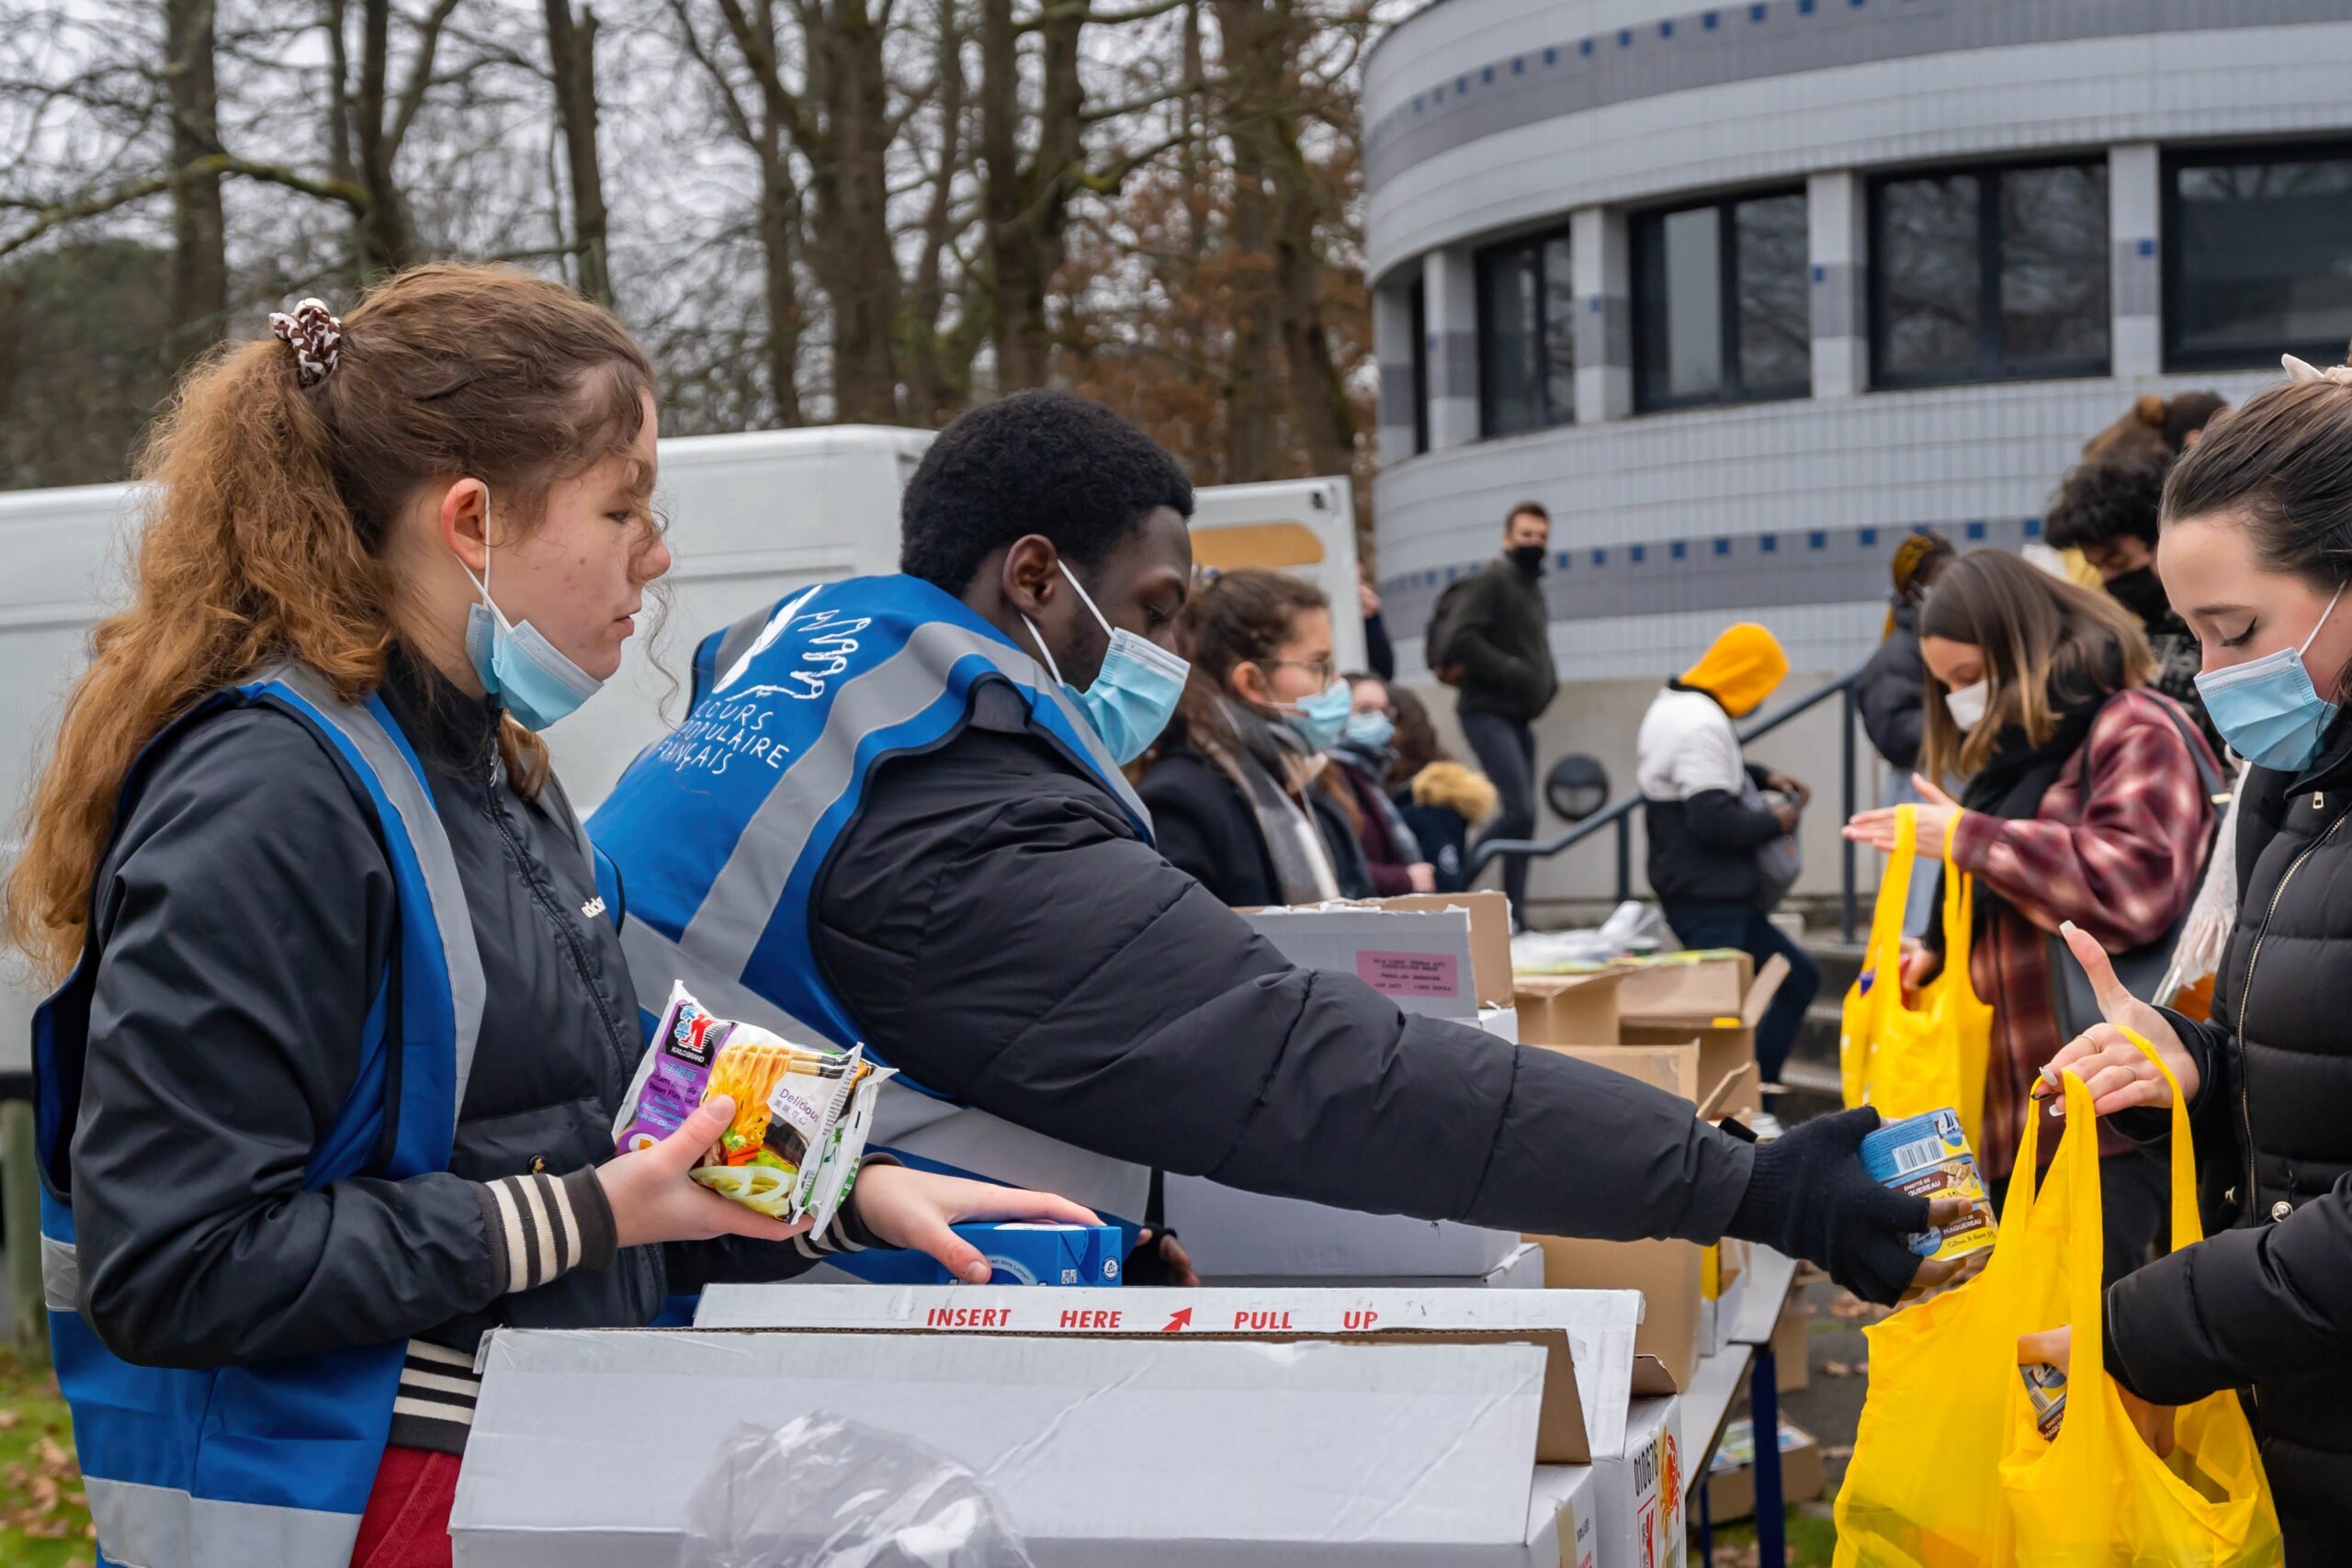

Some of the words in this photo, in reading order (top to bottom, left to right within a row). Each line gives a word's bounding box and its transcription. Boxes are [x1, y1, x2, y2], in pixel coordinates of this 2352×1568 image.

[694, 699, 775, 731] COURS
[659, 739, 733, 775] FRANÇAIS
[676, 719, 790, 769] POPULAIRE
[779, 1088, 820, 1122] Delicious
[1908, 1180, 1941, 1197] QUEREAU
[927, 1309, 1011, 1326] INSERT
[1060, 1311, 1122, 1329] HERE
[1234, 1312, 1293, 1330] PULL
[1344, 1312, 1378, 1329] UP
[1634, 1438, 1658, 1498] 010676
